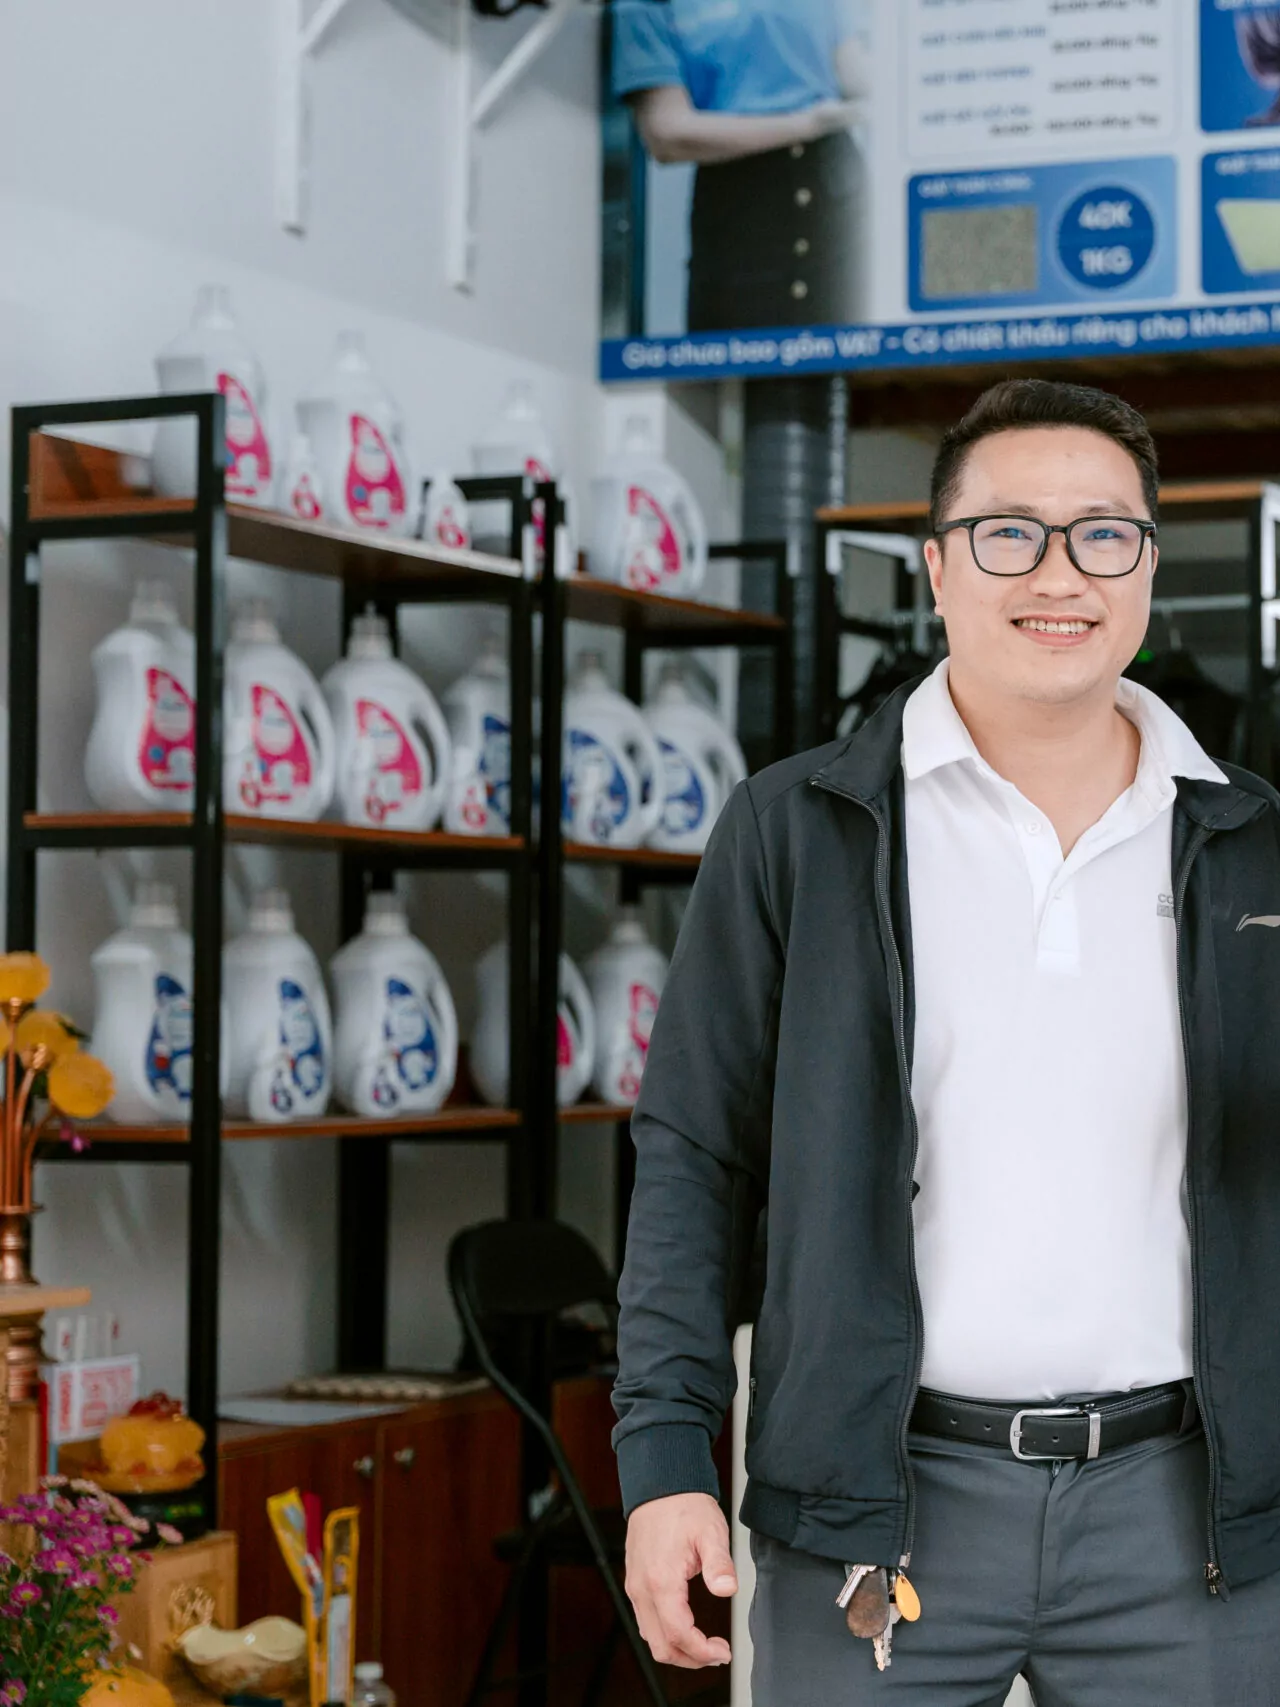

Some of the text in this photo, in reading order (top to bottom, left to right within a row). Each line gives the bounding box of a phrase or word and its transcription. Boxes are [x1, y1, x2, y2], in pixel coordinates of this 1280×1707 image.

[1079, 201, 1132, 230] 40K
[1080, 245, 1133, 276] 1KG
[622, 339, 667, 370] Giá
[668, 341, 728, 367] chưa
[728, 337, 778, 363] bao
[780, 330, 835, 366] gồm
[836, 329, 884, 358] VAT
[902, 326, 940, 354] Có
[942, 322, 1004, 352] chiết
[1006, 321, 1069, 349] khấu
[1072, 316, 1138, 348] riêng
[1139, 313, 1188, 341] cho
[1189, 308, 1270, 338] khách
